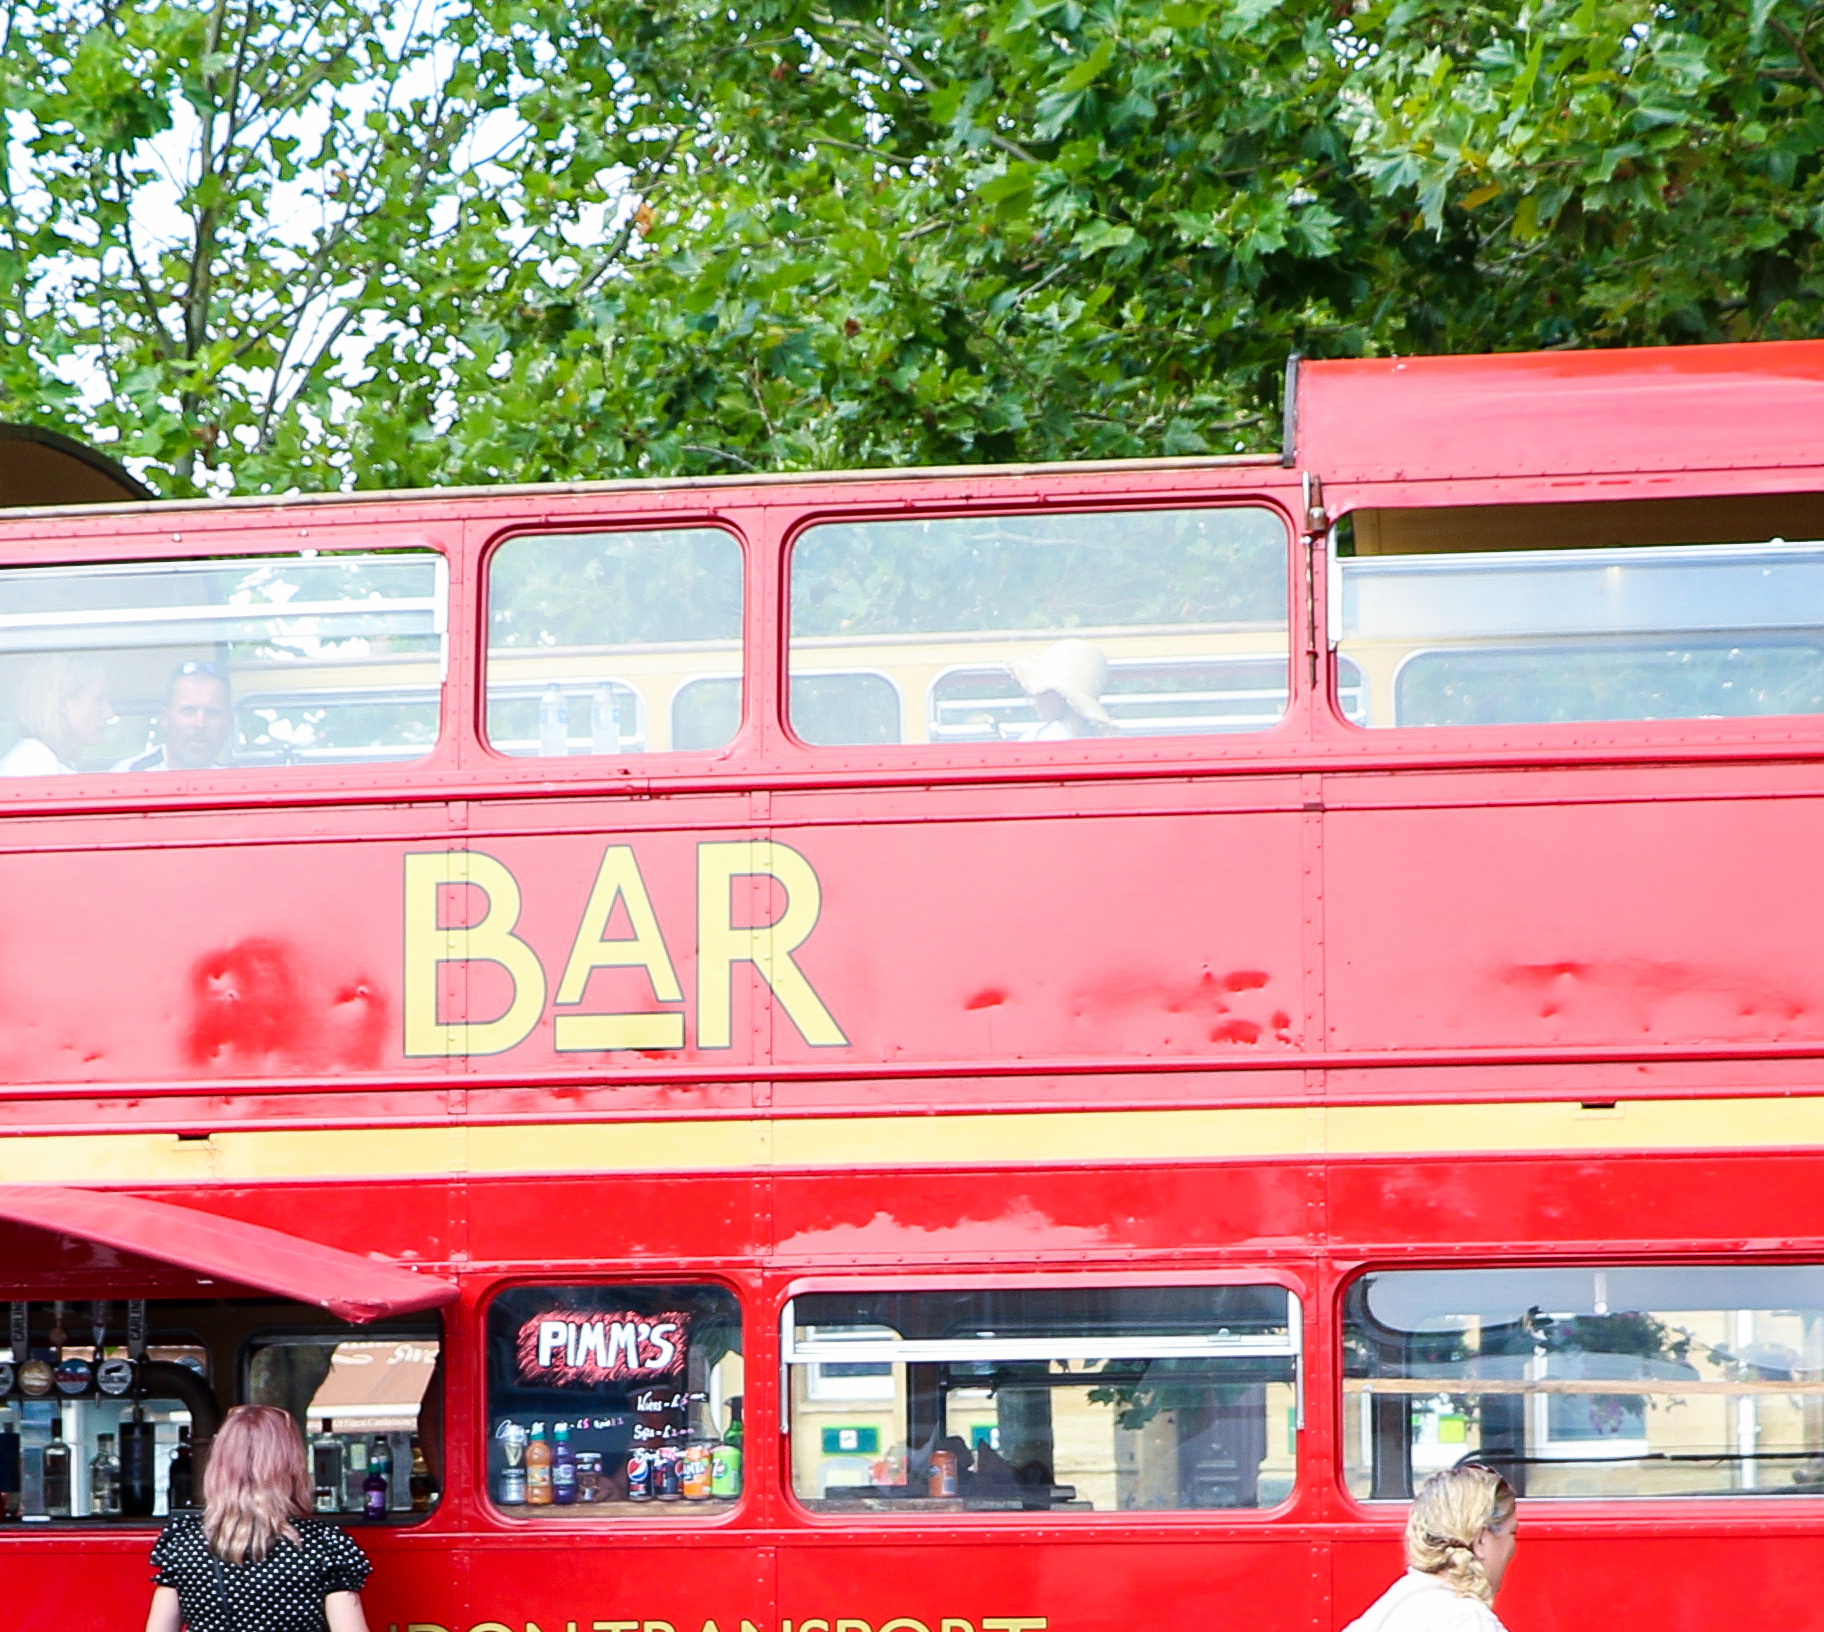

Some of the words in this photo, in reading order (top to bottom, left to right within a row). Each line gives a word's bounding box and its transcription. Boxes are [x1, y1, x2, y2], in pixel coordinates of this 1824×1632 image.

[403, 839, 852, 1058] BAR
[12, 1301, 25, 1343] CARLIN
[129, 1300, 143, 1341] CARLIN
[538, 1320, 677, 1369] PIMM'S
